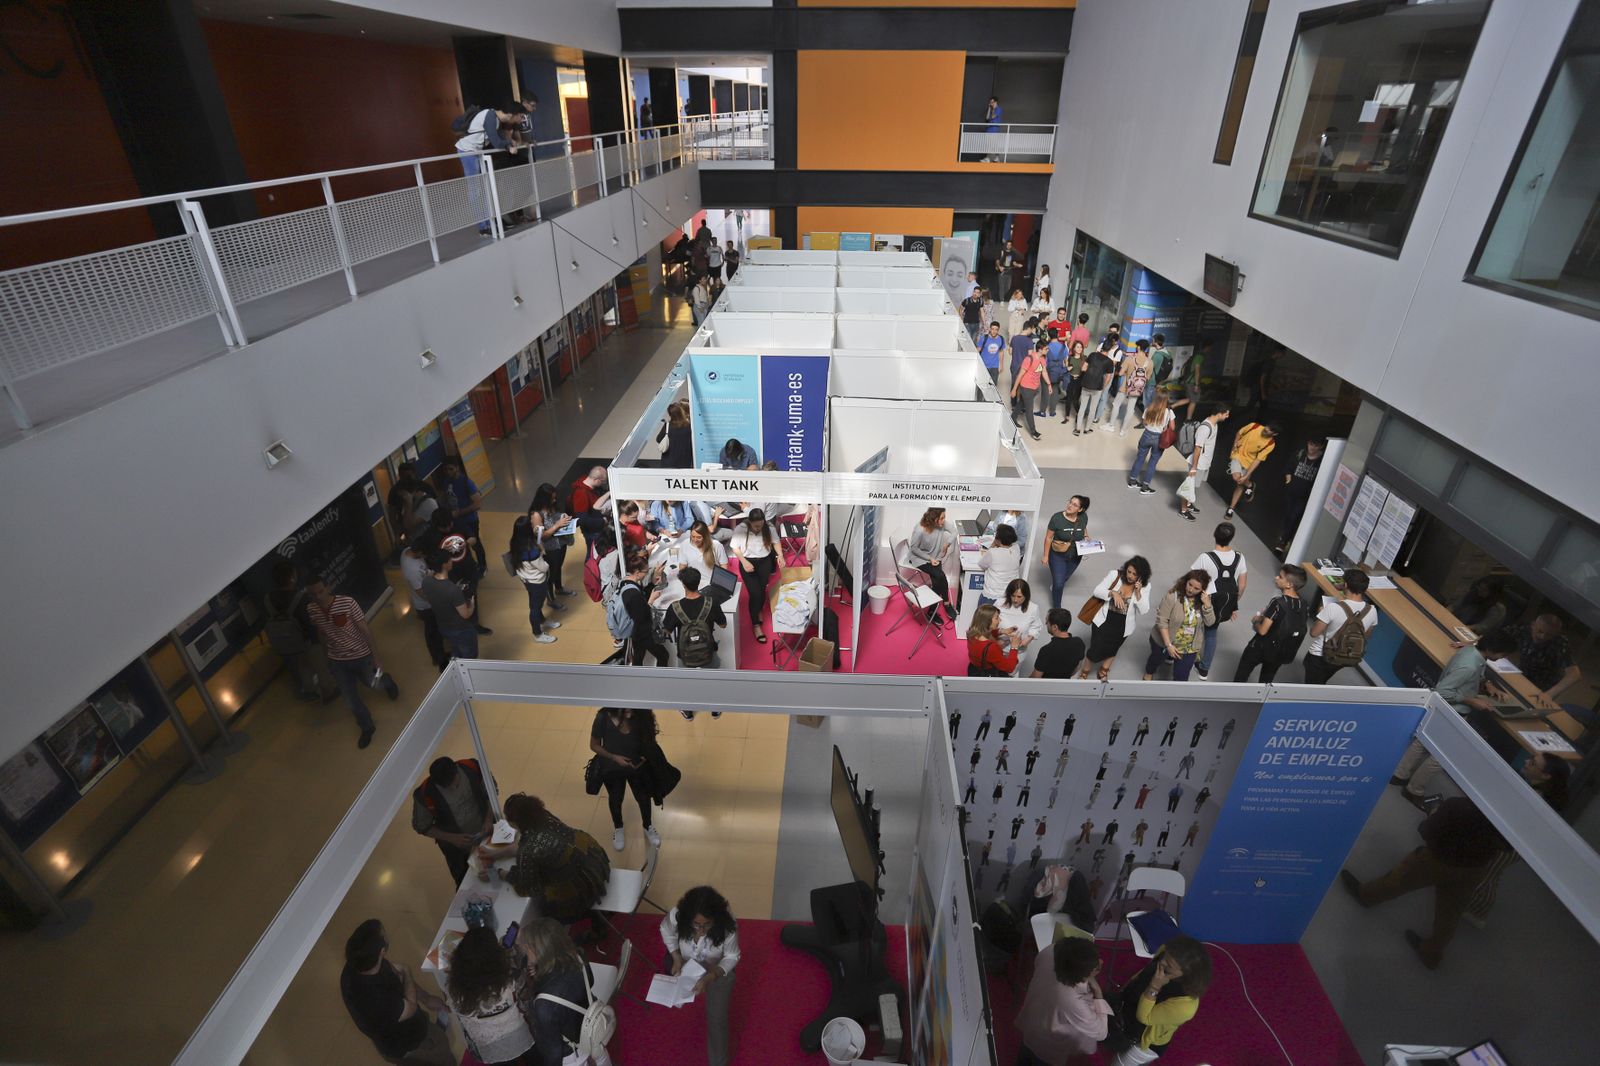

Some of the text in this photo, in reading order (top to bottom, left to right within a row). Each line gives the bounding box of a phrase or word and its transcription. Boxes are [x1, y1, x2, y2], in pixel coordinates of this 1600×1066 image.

[665, 478, 759, 491] TALENT TANK
[892, 483, 972, 492] INSTITUTO MUNICIPAL
[900, 492, 943, 501] FORMACIÓN
[1272, 719, 1358, 733] SERVICIO
[1264, 736, 1351, 750] ANDALUZ
[1259, 753, 1363, 767] DE EMPLEO
[1254, 770, 1274, 780] Nos
[1278, 772, 1336, 783] empleamos
[1337, 776, 1359, 784] por
